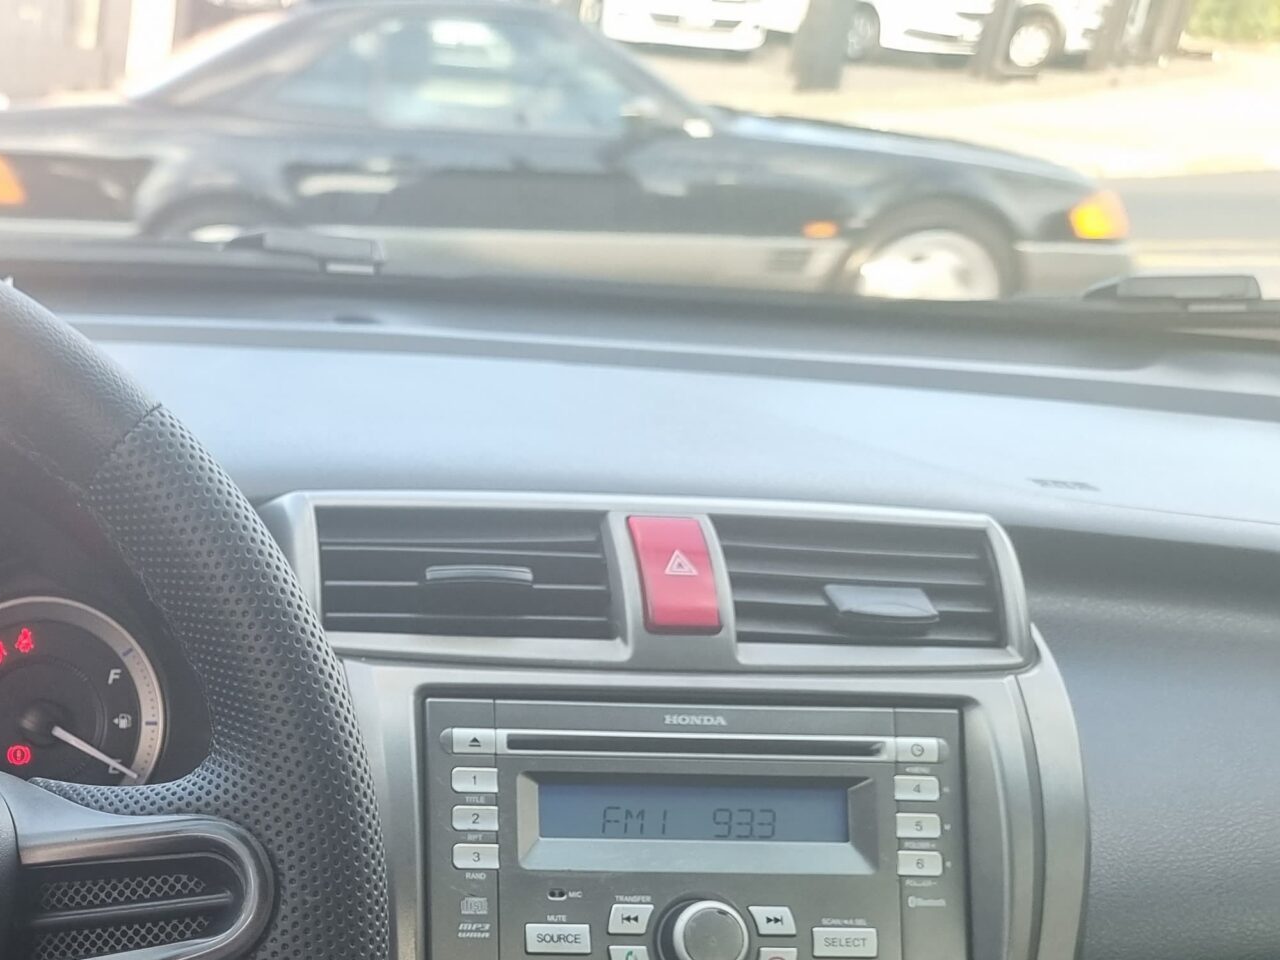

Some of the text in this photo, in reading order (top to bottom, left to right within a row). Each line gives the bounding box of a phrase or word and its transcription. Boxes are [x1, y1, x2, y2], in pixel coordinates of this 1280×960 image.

[108, 669, 121, 684] F
[664, 714, 728, 726] HONDA
[472, 775, 478, 785] 1
[912, 784, 921, 794] 4
[472, 813, 480, 824] 2
[472, 852, 480, 862] 3
[915, 858, 924, 869] 6
[547, 914, 567, 922] MUTE
[537, 933, 581, 944] SOURCE
[824, 937, 867, 947] SELECT
